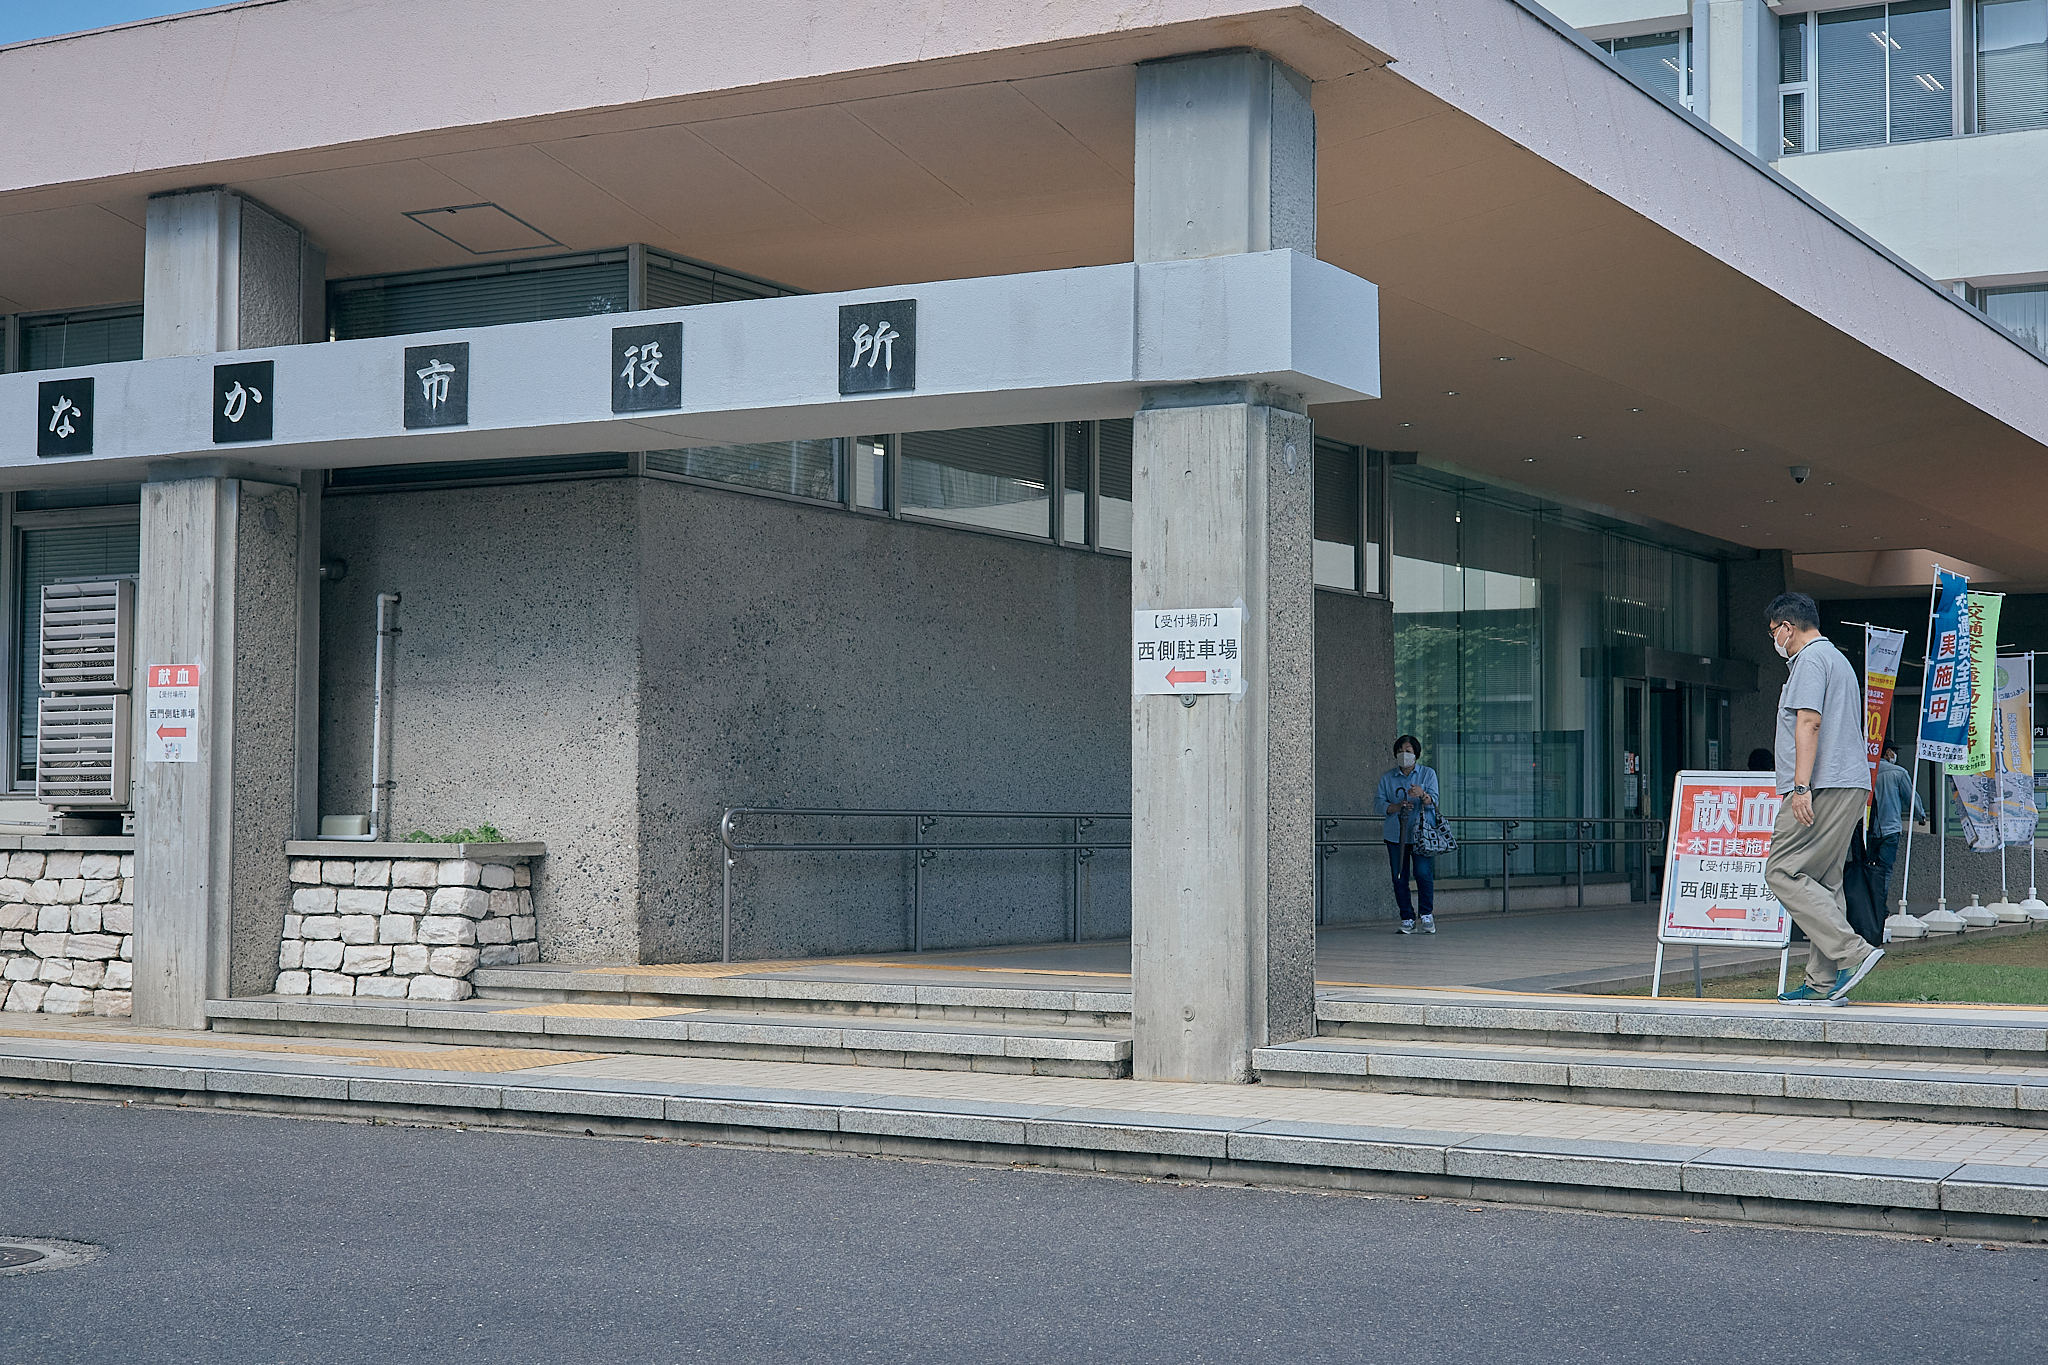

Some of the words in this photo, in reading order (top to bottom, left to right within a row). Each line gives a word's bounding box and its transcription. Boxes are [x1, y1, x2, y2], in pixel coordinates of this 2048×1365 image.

[1154, 613, 1218, 628] 【受付場所】
[1137, 639, 1238, 661] 西側駐車場
[1948, 593, 1970, 728] 交通安全運動
[158, 668, 190, 686] 献血
[1930, 634, 1955, 719] 実施中
[149, 708, 196, 719] 西門側駐車場
[1690, 791, 1783, 834] 献血
[1699, 859, 1763, 874] 【受付場所】
[1680, 881, 1777, 902] 西側駐車場
